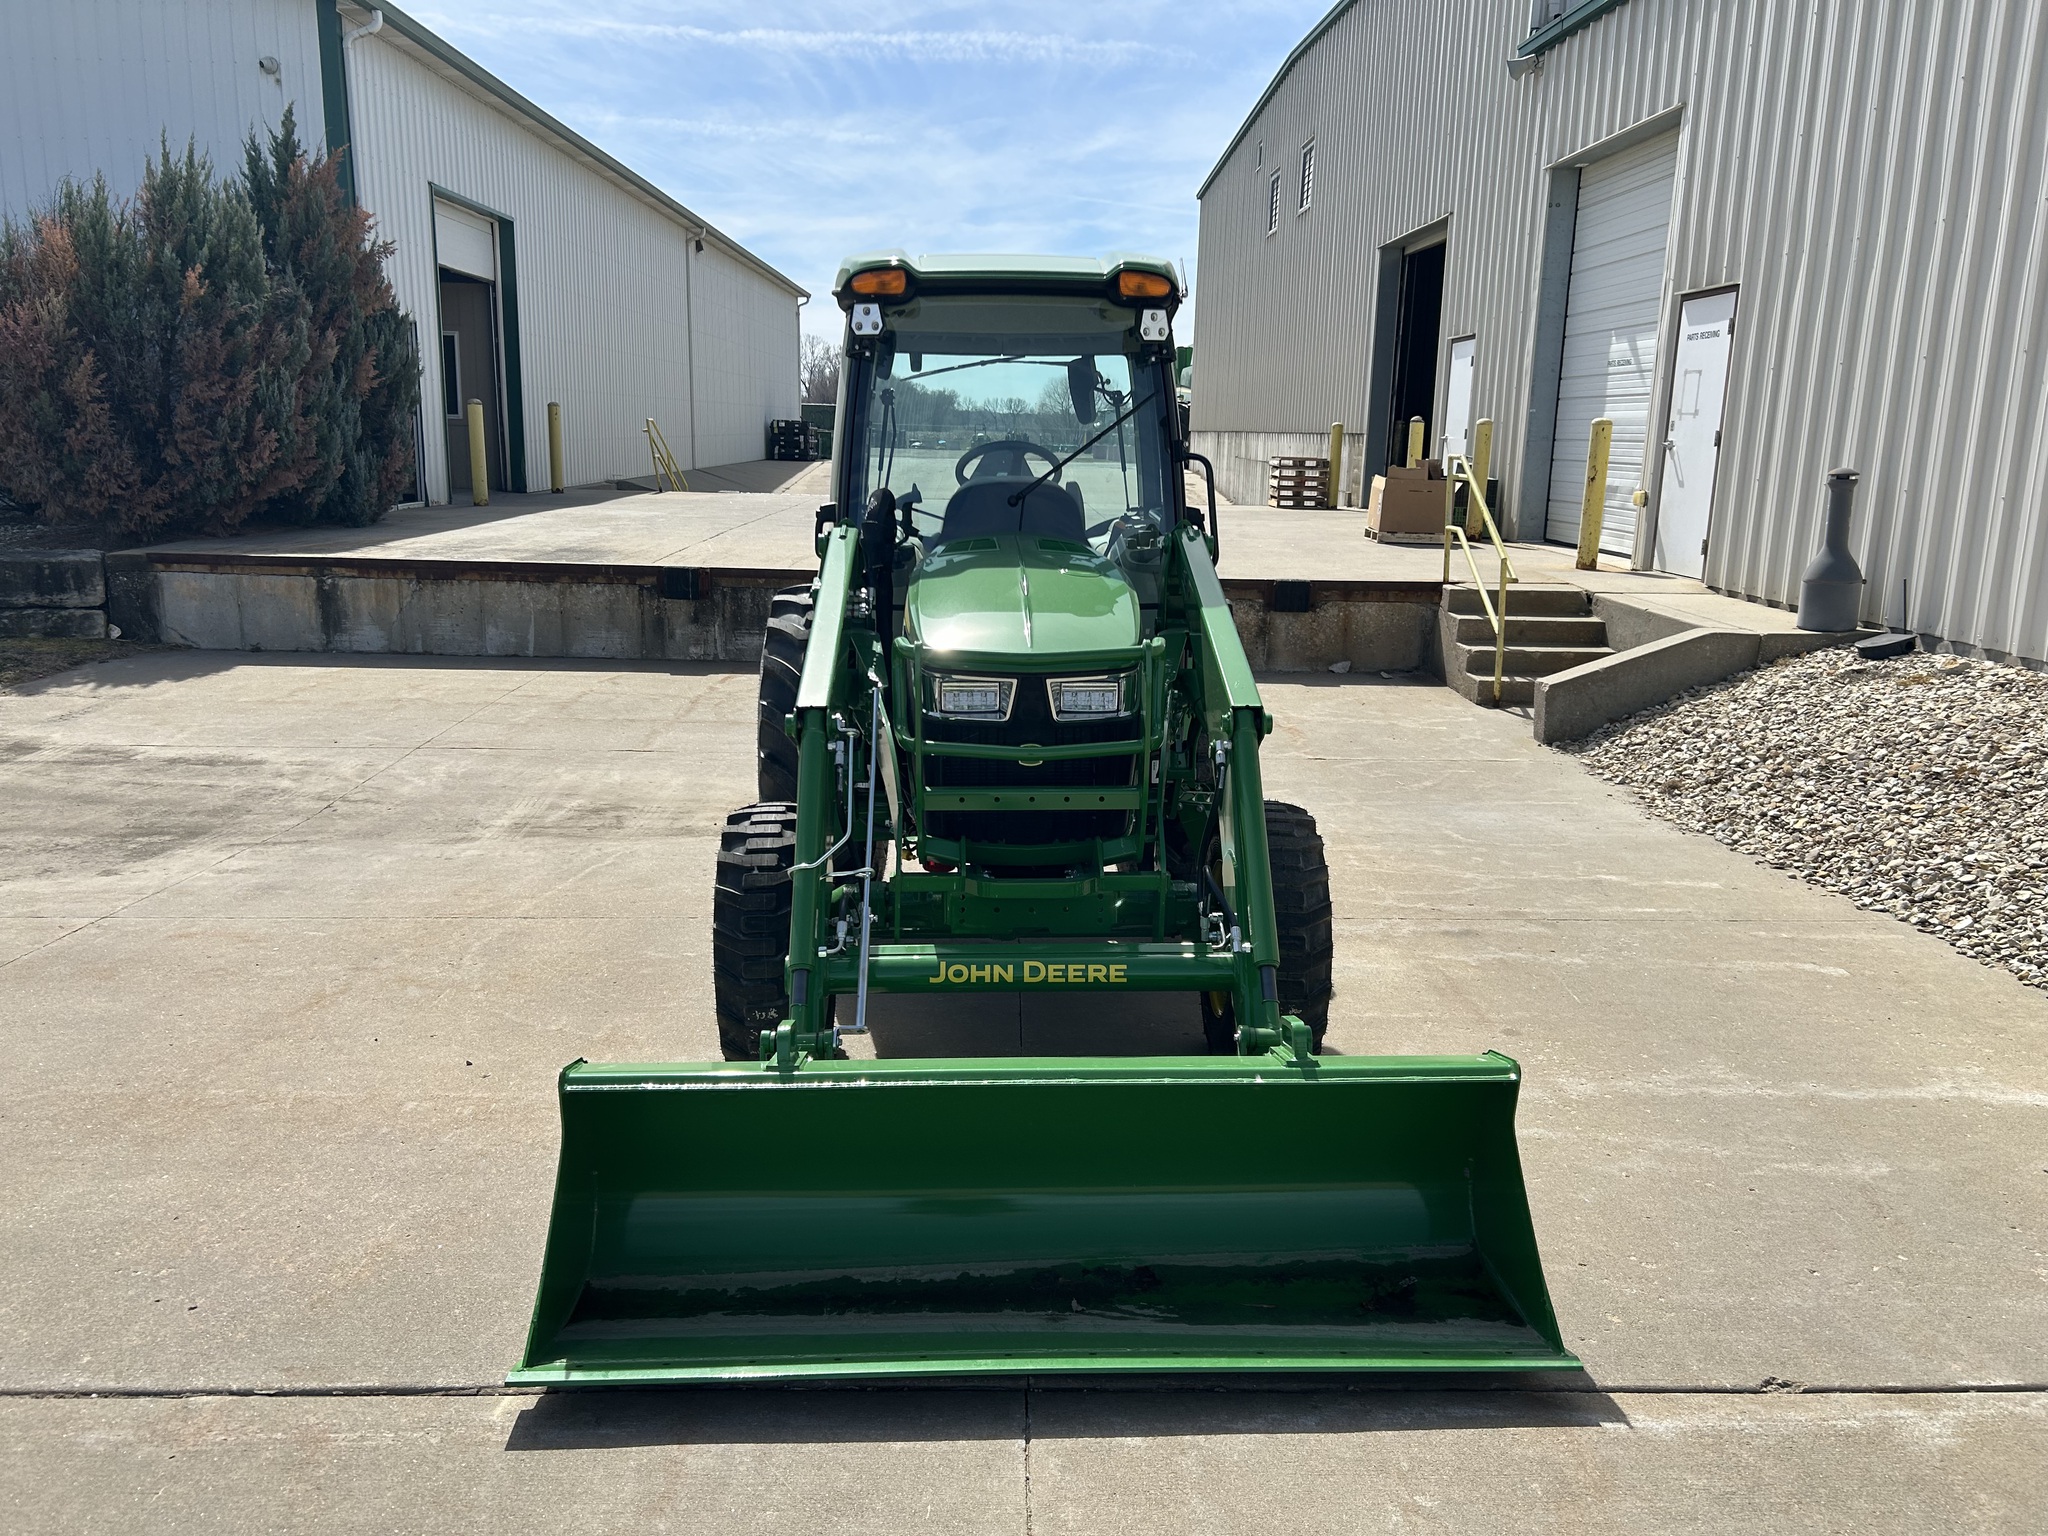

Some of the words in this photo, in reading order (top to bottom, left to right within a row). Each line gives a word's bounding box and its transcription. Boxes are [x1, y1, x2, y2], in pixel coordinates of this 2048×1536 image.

[1687, 332, 1699, 341] PARTS
[1700, 329, 1720, 340] RECEIVING
[1617, 358, 1632, 366] RECEIVING
[929, 961, 1013, 983] JOHN
[1023, 961, 1127, 983] DEERE
